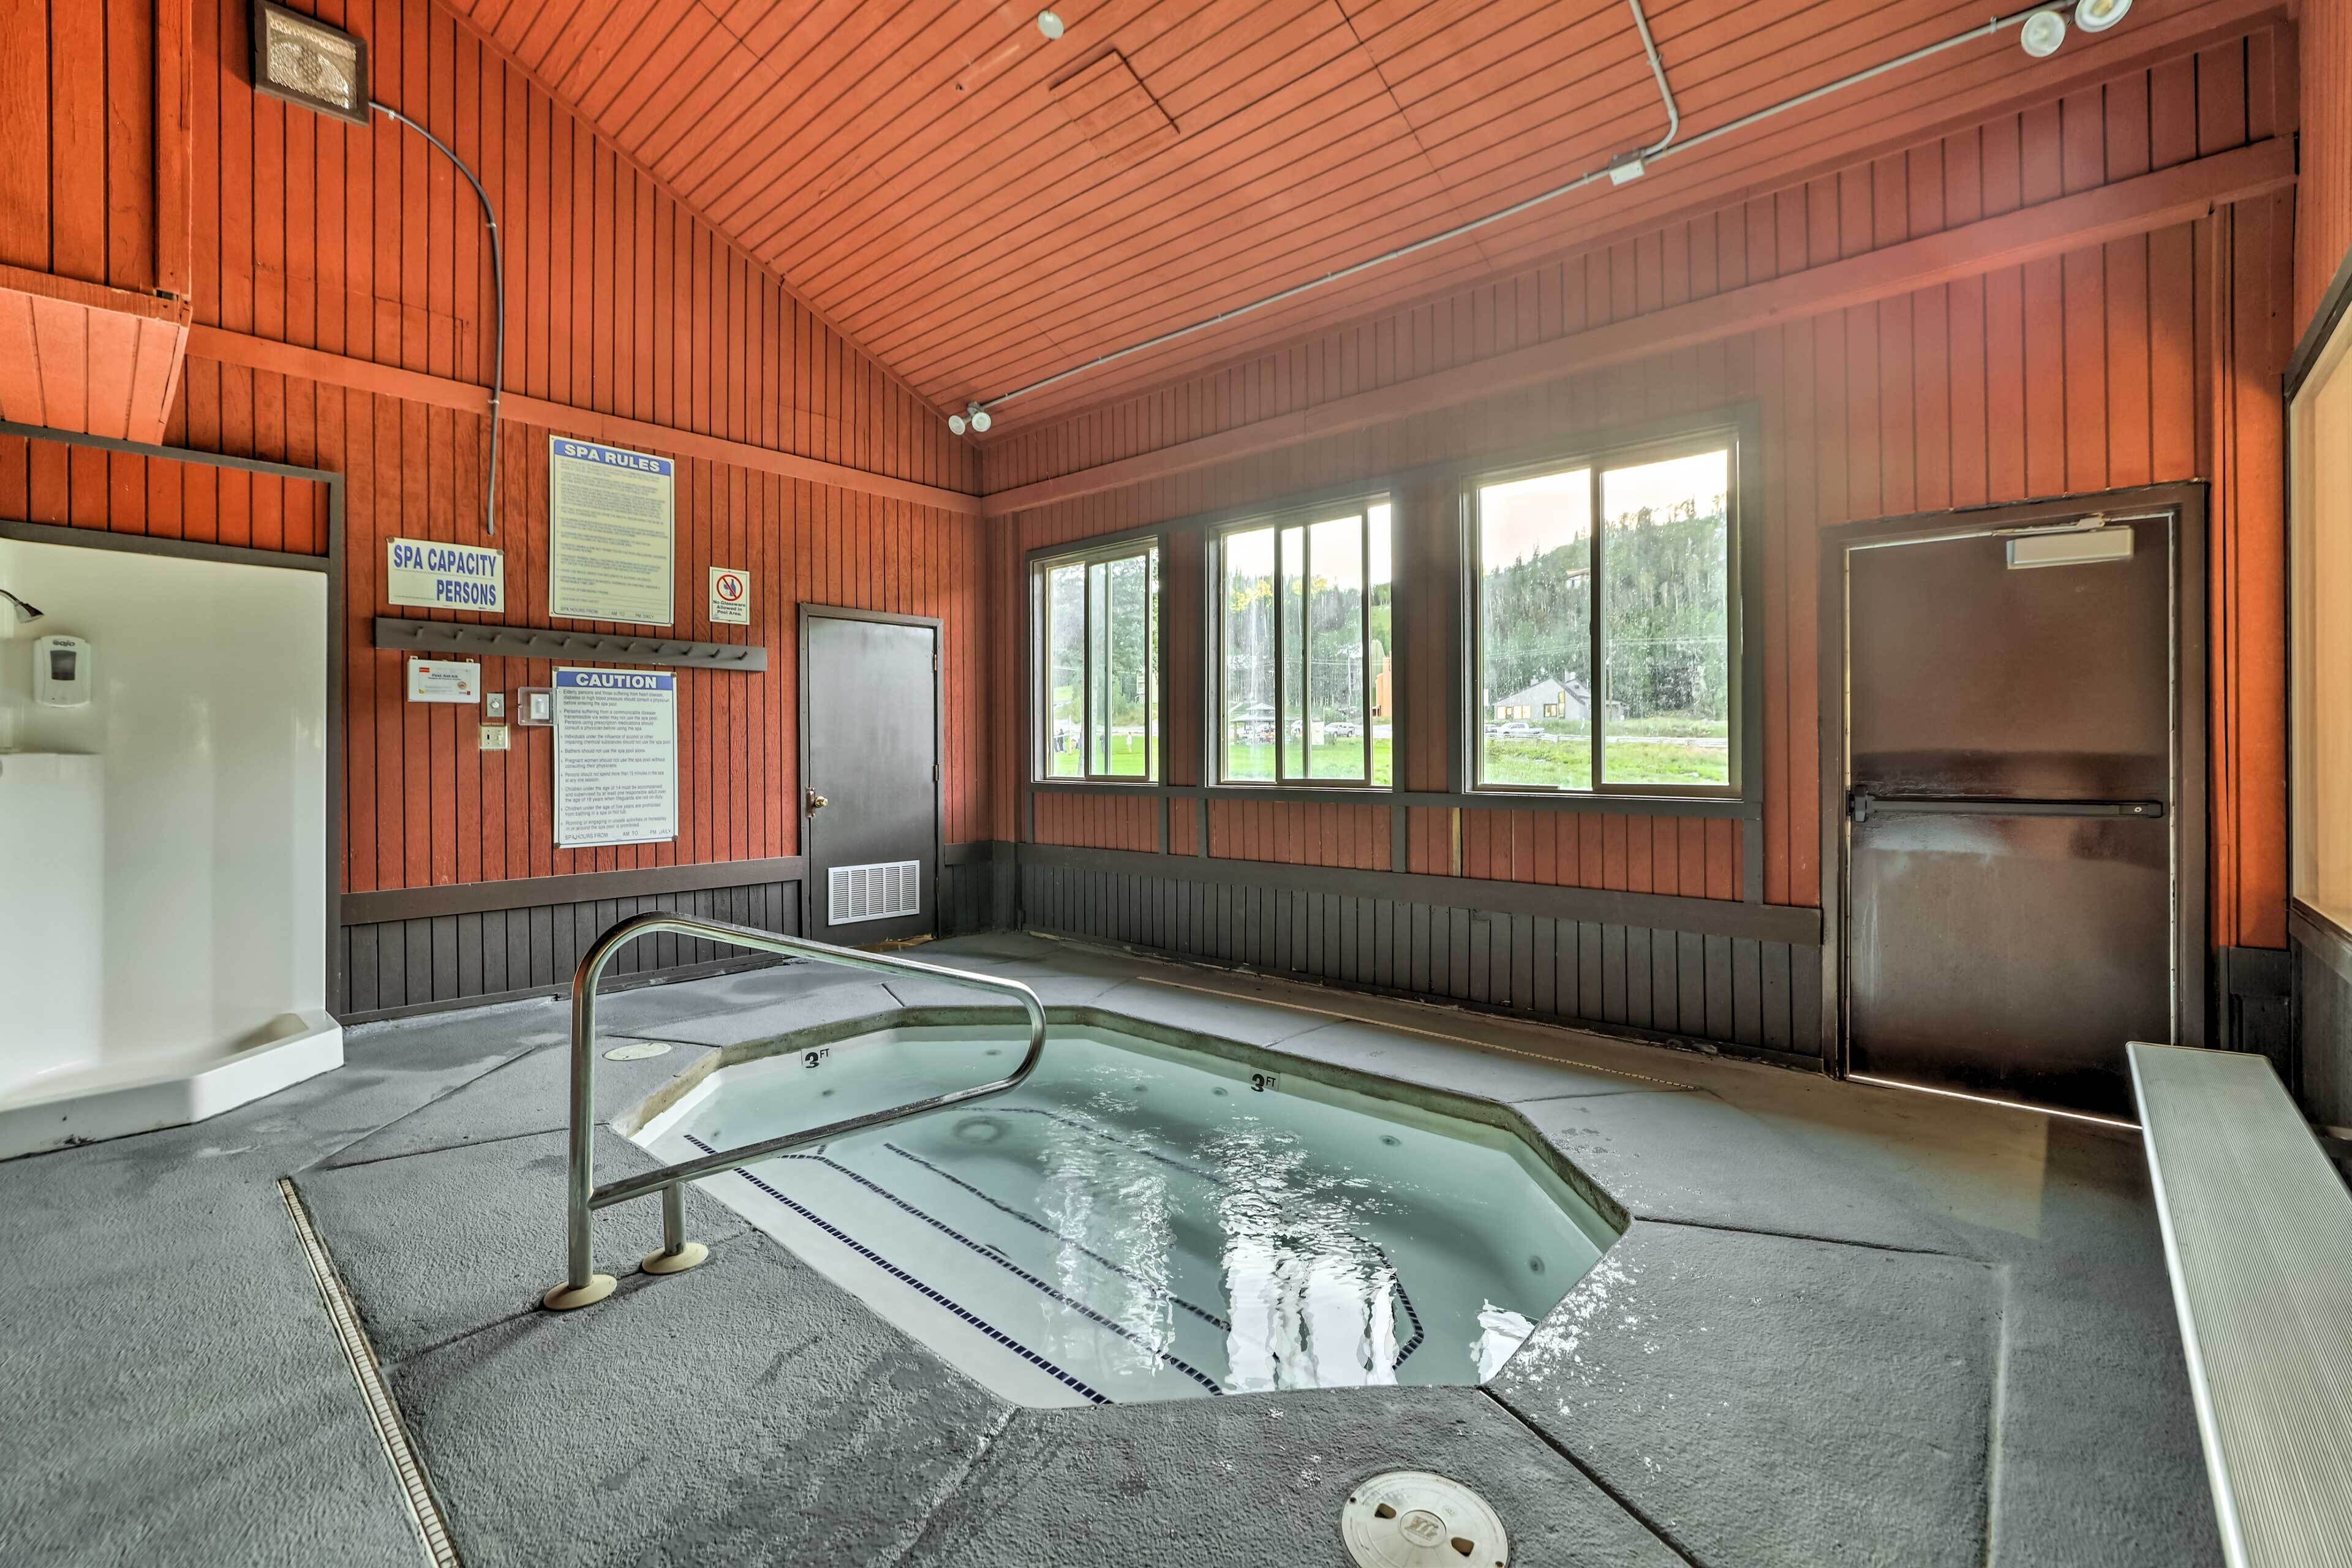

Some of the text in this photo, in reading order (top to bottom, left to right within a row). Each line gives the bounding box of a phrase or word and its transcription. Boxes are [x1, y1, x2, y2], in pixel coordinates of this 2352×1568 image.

[564, 444, 600, 461] SPA
[605, 451, 660, 472] RULES
[393, 544, 496, 577] SPA CAPACITY
[436, 579, 496, 606] PERSONS
[576, 673, 657, 688] CAUTION
[805, 1048, 829, 1068] 3 FT
[1251, 1074, 1276, 1092] 3 FT
